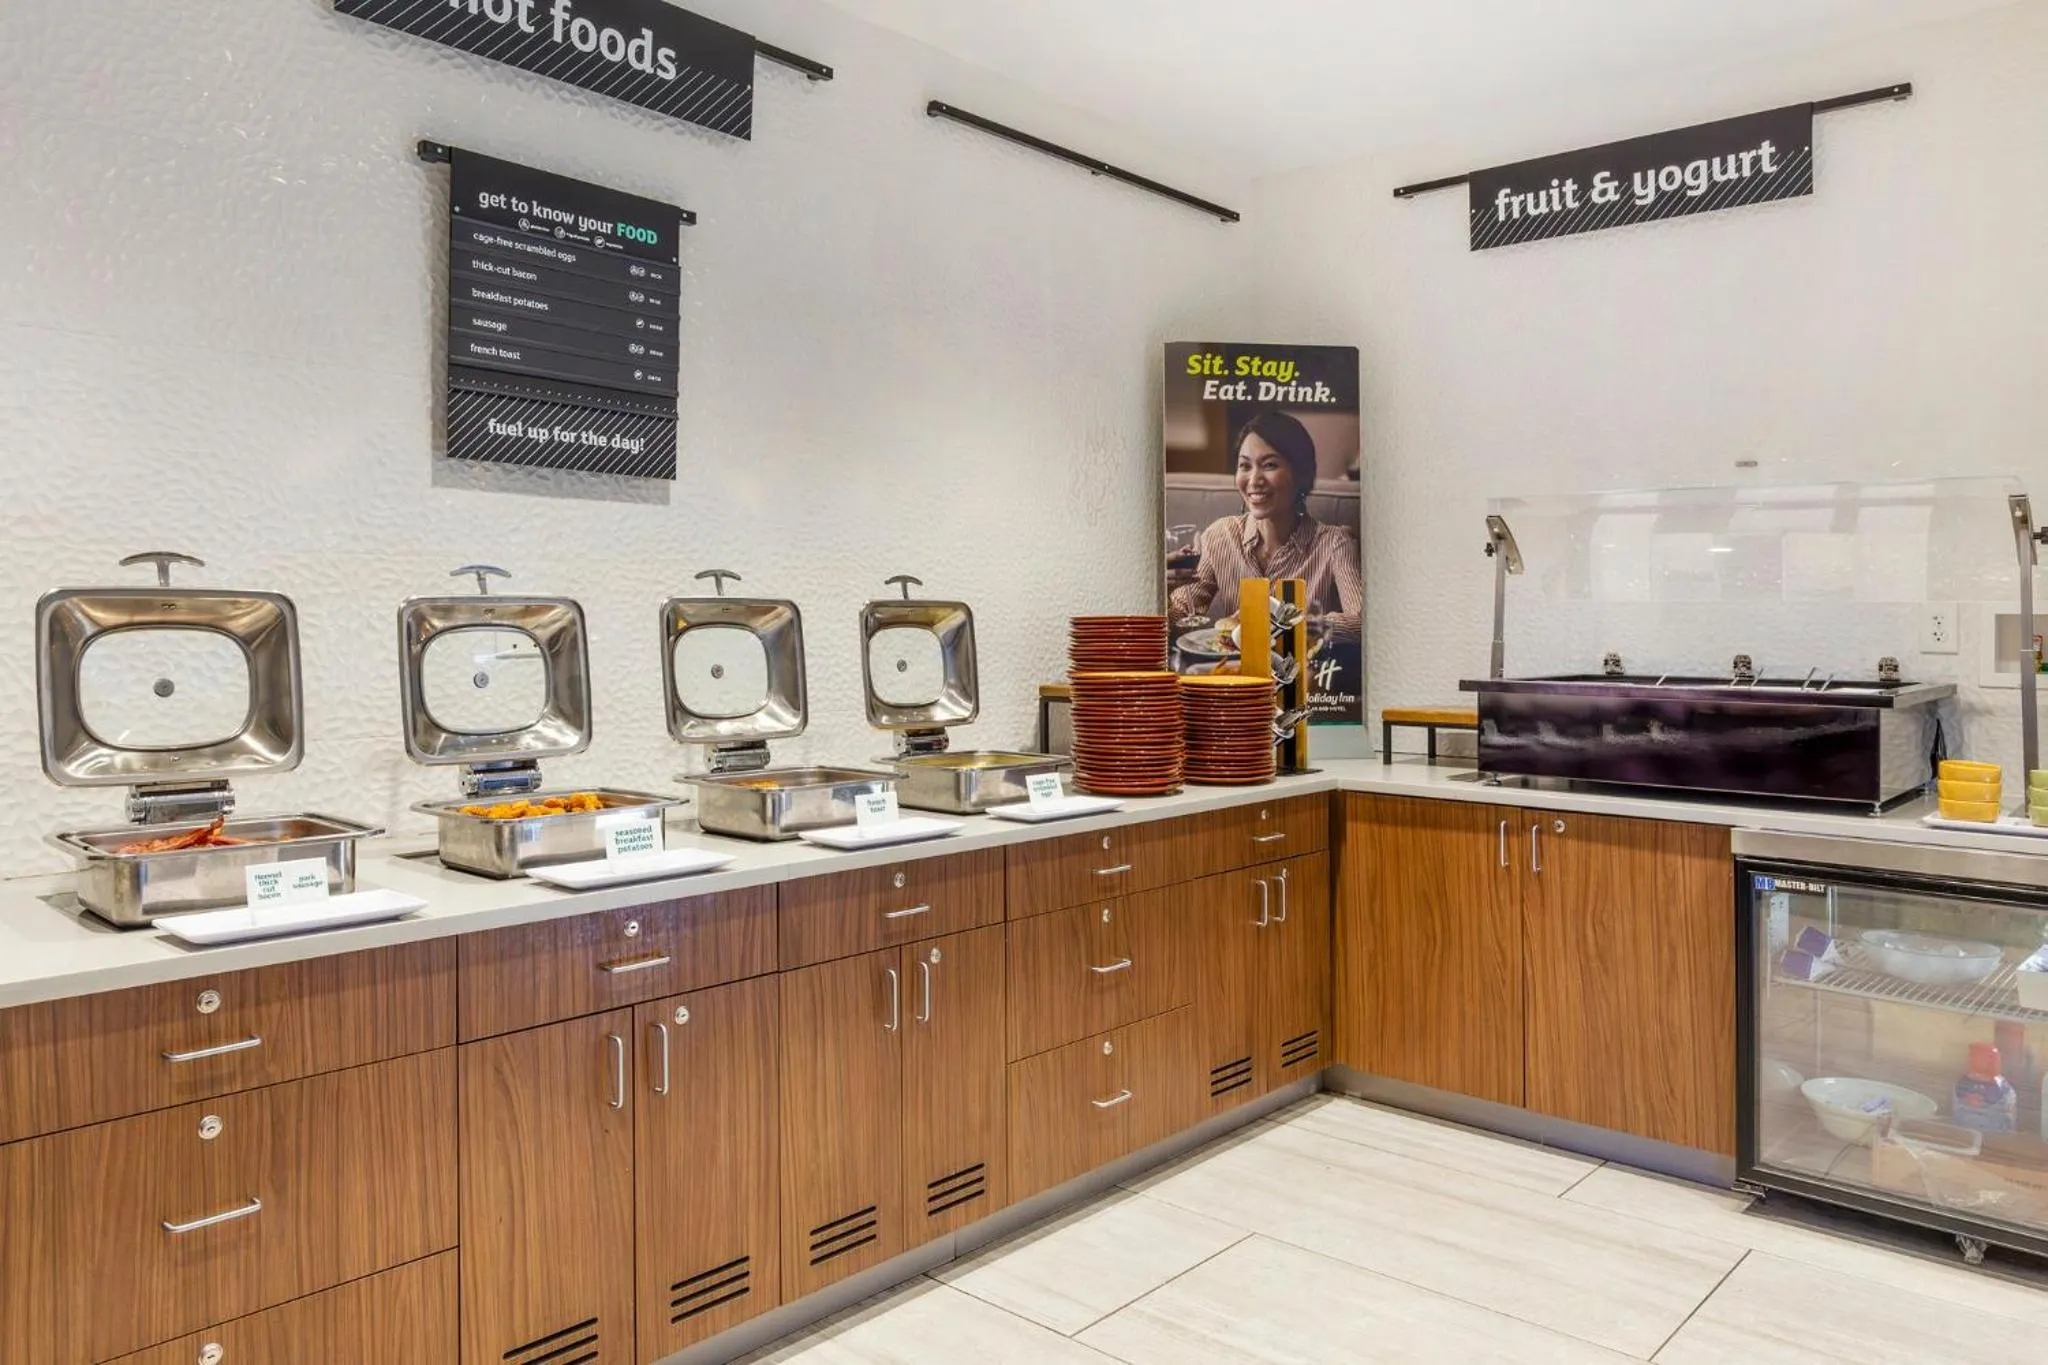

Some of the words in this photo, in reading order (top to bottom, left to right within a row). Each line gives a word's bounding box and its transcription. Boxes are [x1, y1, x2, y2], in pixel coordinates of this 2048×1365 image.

[550, 0, 678, 81] foods
[1494, 178, 1579, 222] fruit
[1590, 171, 1620, 204] &
[1632, 139, 1777, 206] yogurt
[478, 191, 508, 210] get
[511, 197, 529, 214] to
[532, 200, 576, 225] know
[578, 215, 614, 235] your
[615, 222, 659, 245] FOOD
[473, 231, 514, 248] cage-free
[514, 240, 557, 258] scrambled
[557, 251, 577, 264] eggs
[471, 259, 512, 276] thick-cut
[511, 266, 538, 281] bacon
[471, 287, 513, 305] breakfast
[512, 295, 549, 311] potatoes
[471, 317, 508, 333] sausage
[470, 343, 498, 357] french
[498, 350, 521, 361] toast
[1186, 353, 1230, 376] Sit.
[1234, 355, 1301, 383] Stay.
[1203, 379, 1253, 402] Eat.
[1257, 381, 1337, 404] Drink.
[488, 418, 524, 438] fuel
[527, 425, 549, 443] up
[552, 426, 577, 444] for
[581, 430, 607, 447] the
[611, 434, 645, 454] day!
[1340, 692, 1355, 703] Inn
[615, 825, 652, 836] seasoned
[615, 834, 653, 845] breakfast
[617, 843, 653, 855] potatoes
[1775, 879, 1826, 893] MASTER-BILT
